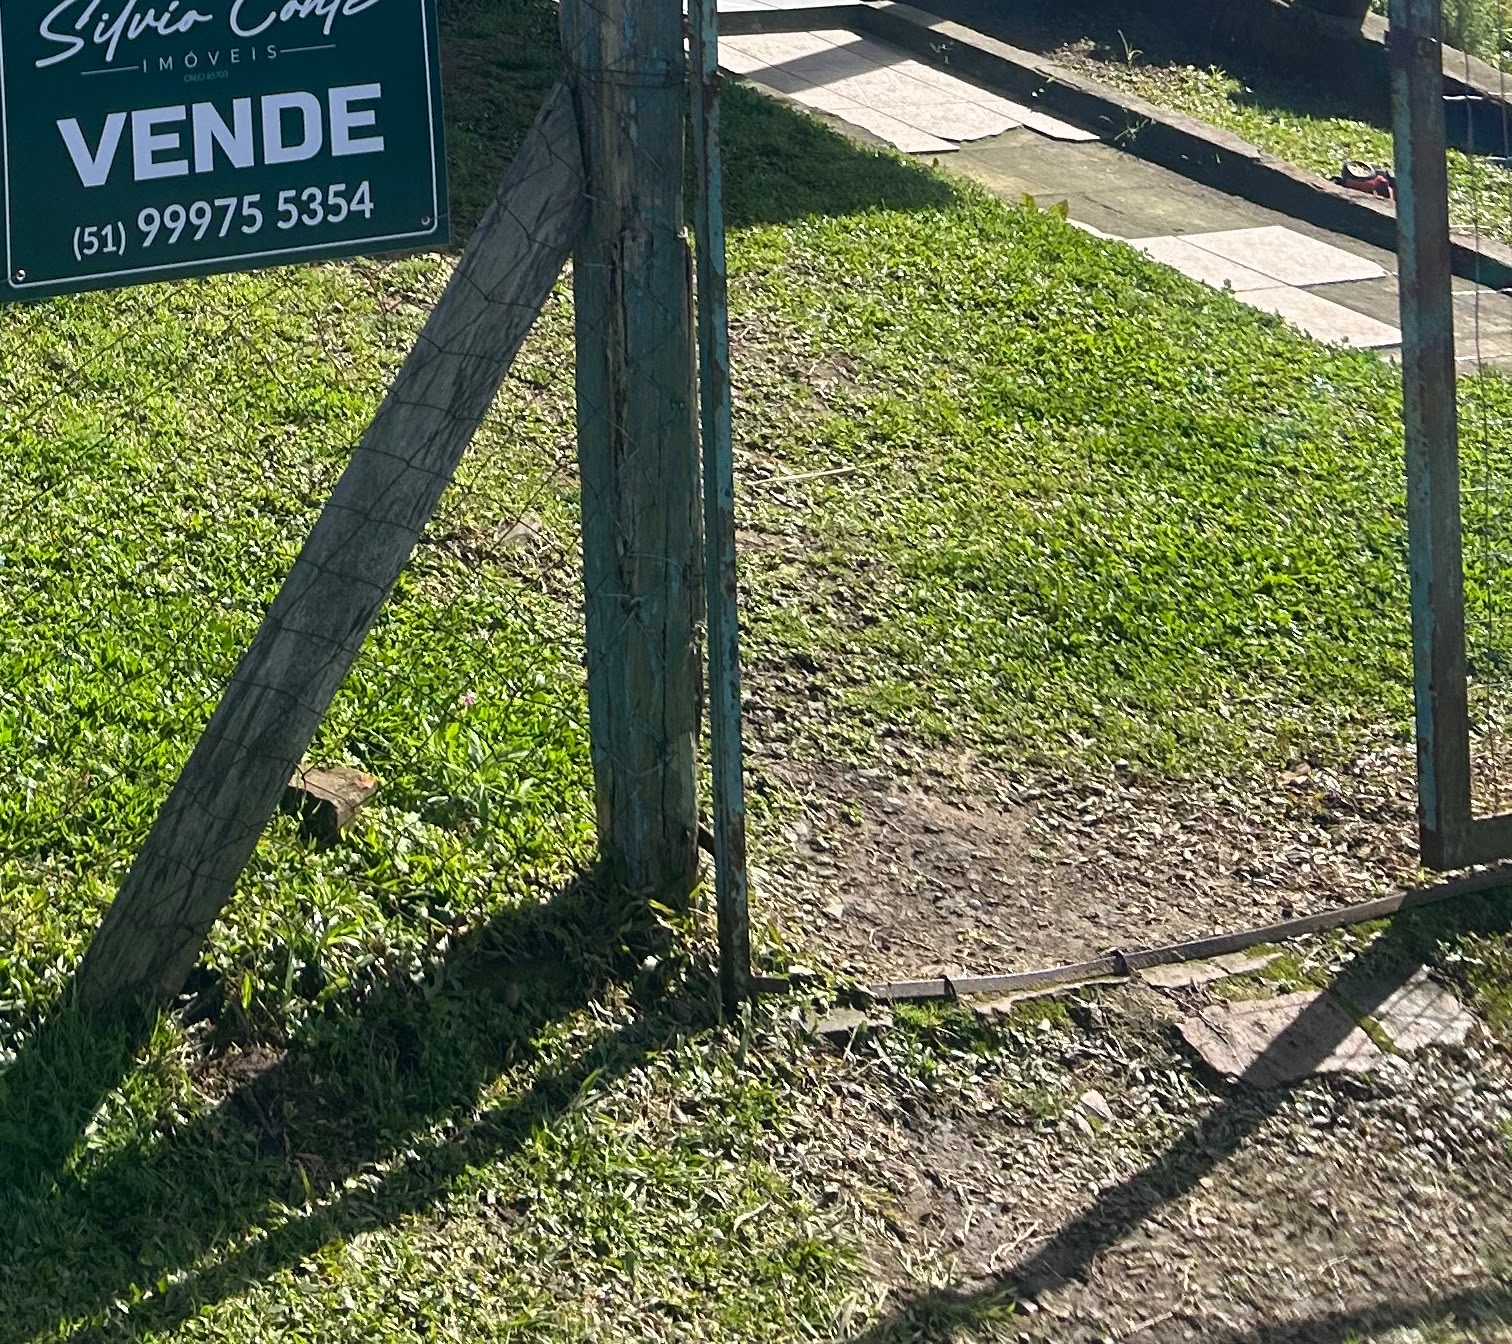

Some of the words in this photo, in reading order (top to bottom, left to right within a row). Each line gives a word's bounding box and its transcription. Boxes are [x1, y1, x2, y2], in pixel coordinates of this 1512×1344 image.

[142, 44, 278, 73] IMÓVEIS
[56, 82, 385, 188] VENDE
[73, 221, 126, 261] (51)
[137, 193, 263, 248] 99975
[276, 180, 375, 230] 5354
